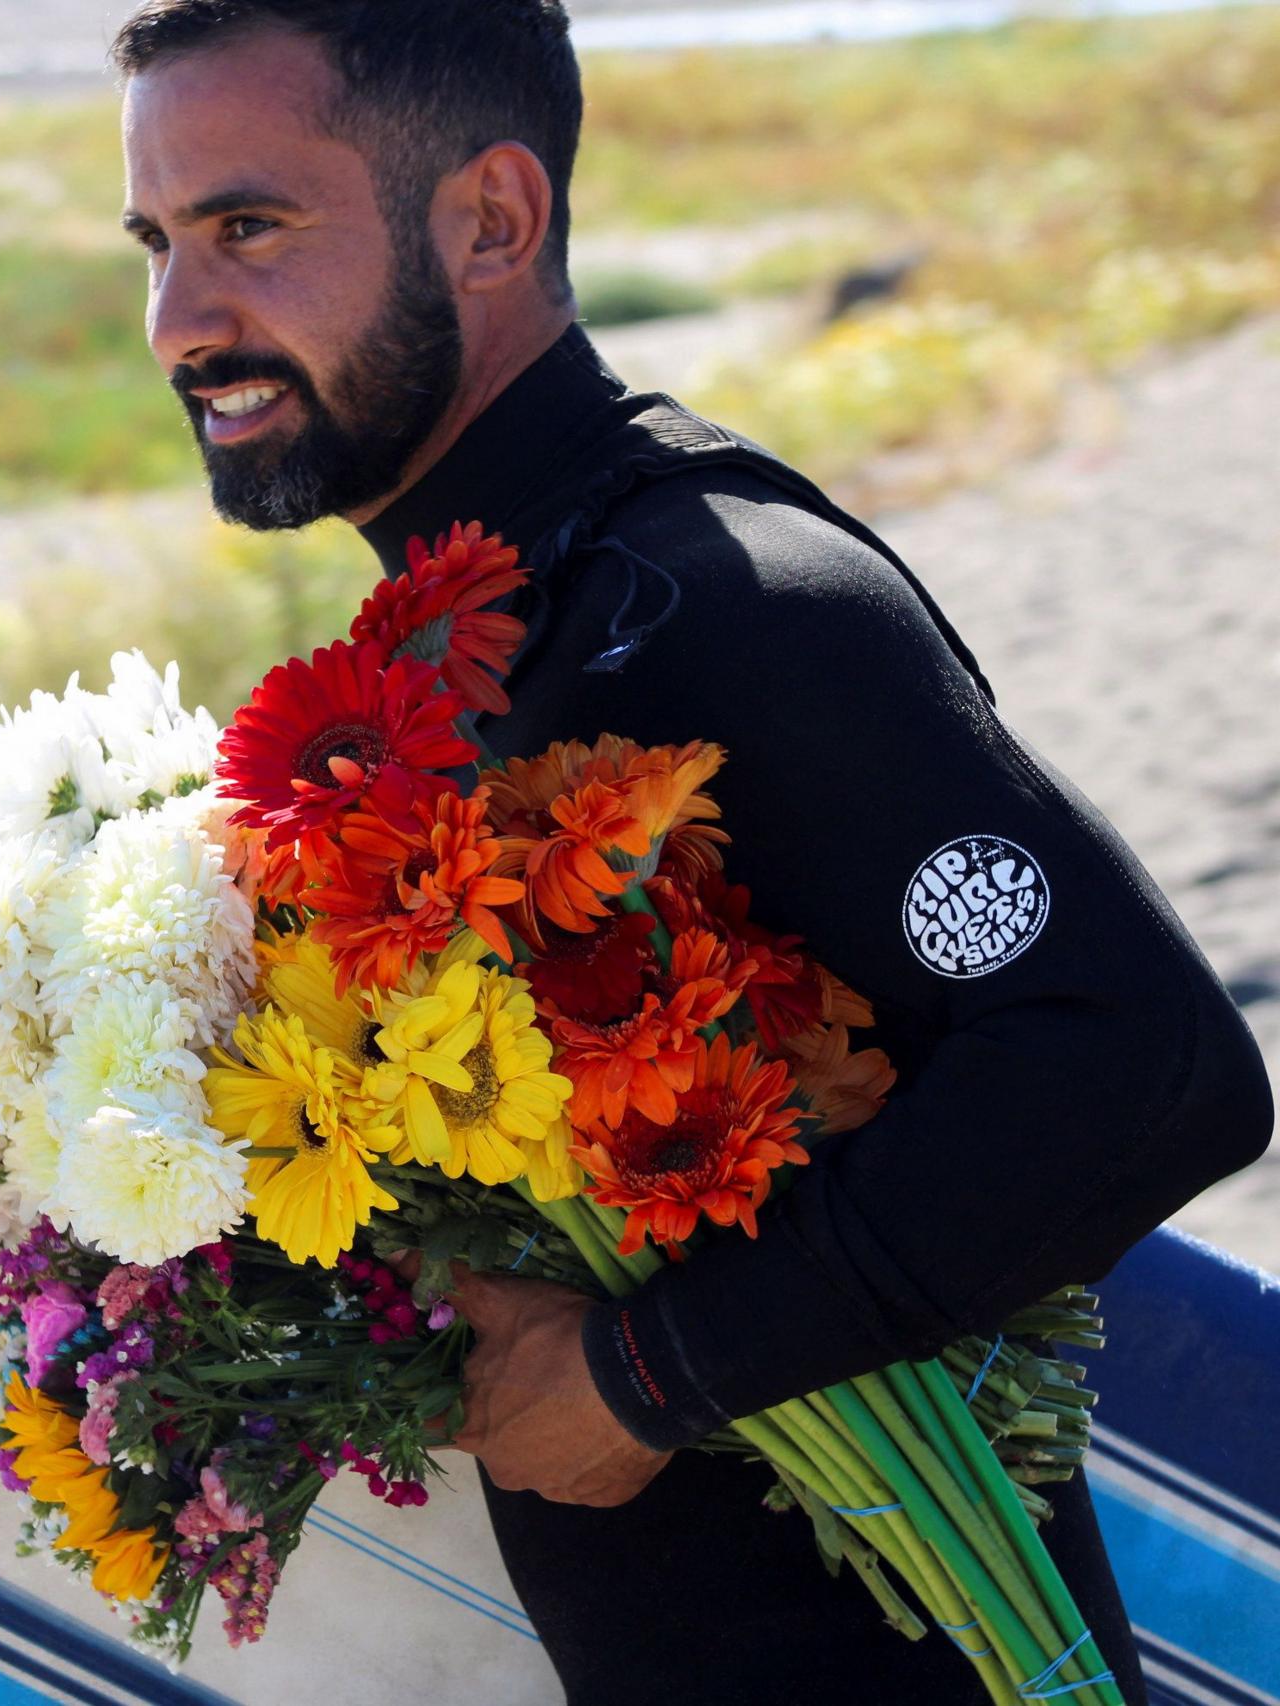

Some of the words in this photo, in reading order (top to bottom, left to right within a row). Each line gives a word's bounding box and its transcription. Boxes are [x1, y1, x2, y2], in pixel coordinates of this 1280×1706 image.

[908, 850, 967, 937] RIP
[920, 858, 1035, 962] CURL
[620, 1310, 638, 1356] DAWN
[634, 1358, 666, 1408] PATROL
